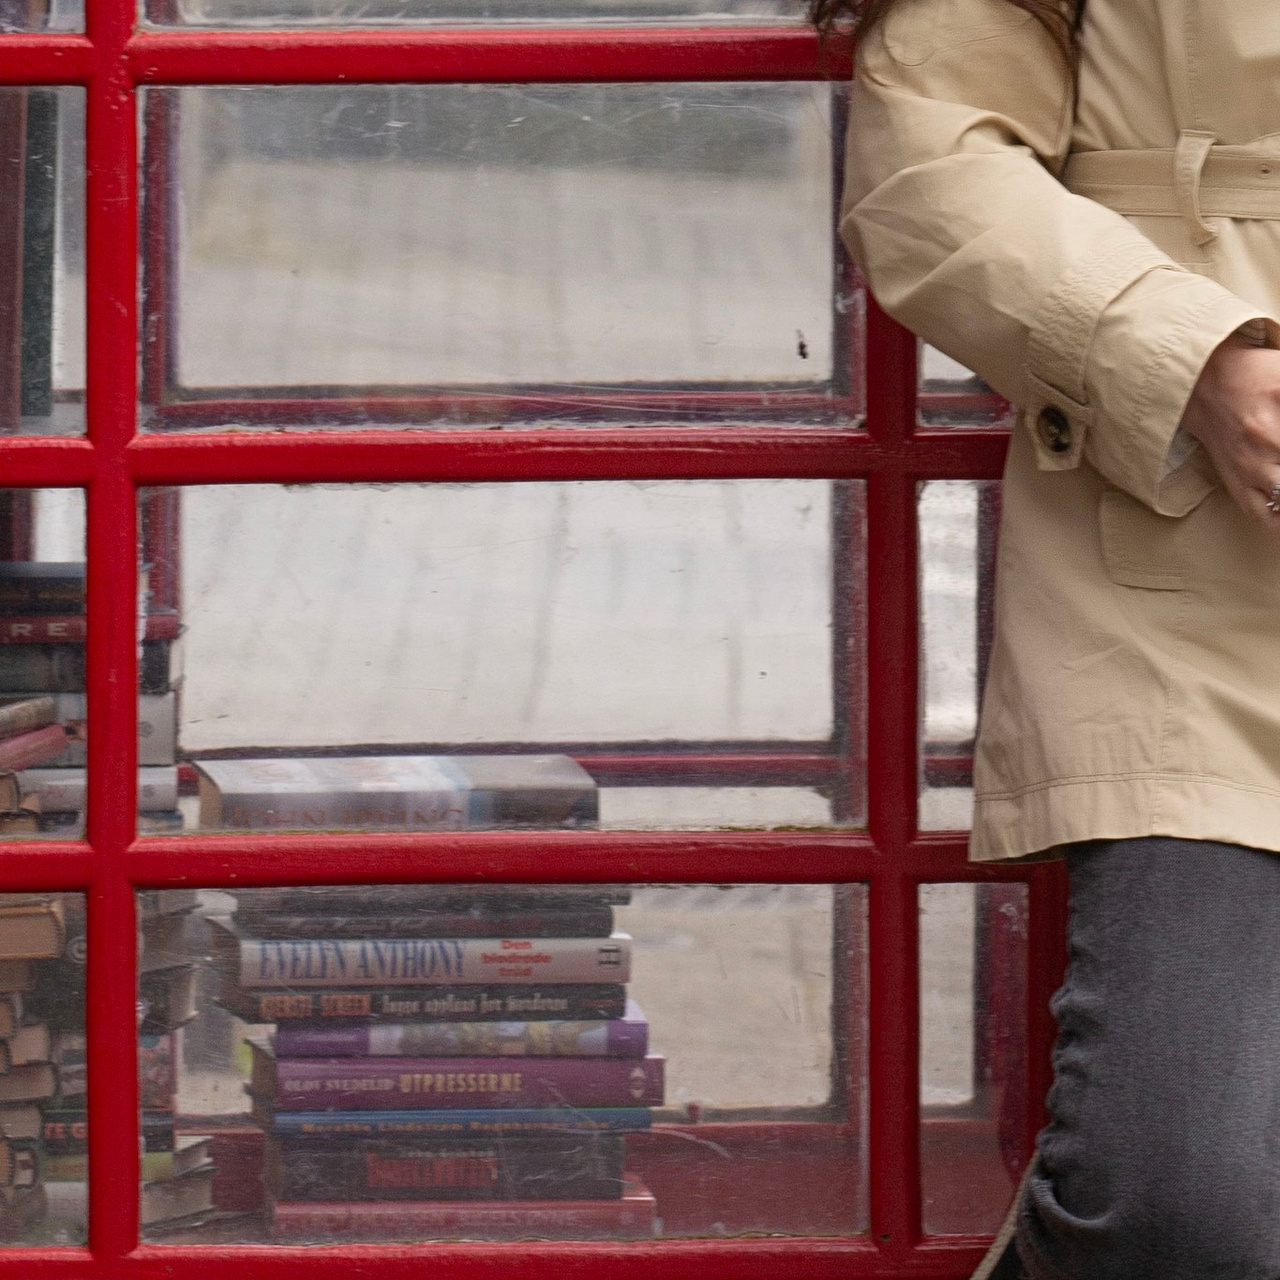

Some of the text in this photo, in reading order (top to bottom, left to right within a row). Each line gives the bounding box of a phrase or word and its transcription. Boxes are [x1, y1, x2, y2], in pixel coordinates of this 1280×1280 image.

[259, 940, 464, 980] EVELYN ANTHONY
[399, 1073, 523, 1093] UTPRESSERNE
